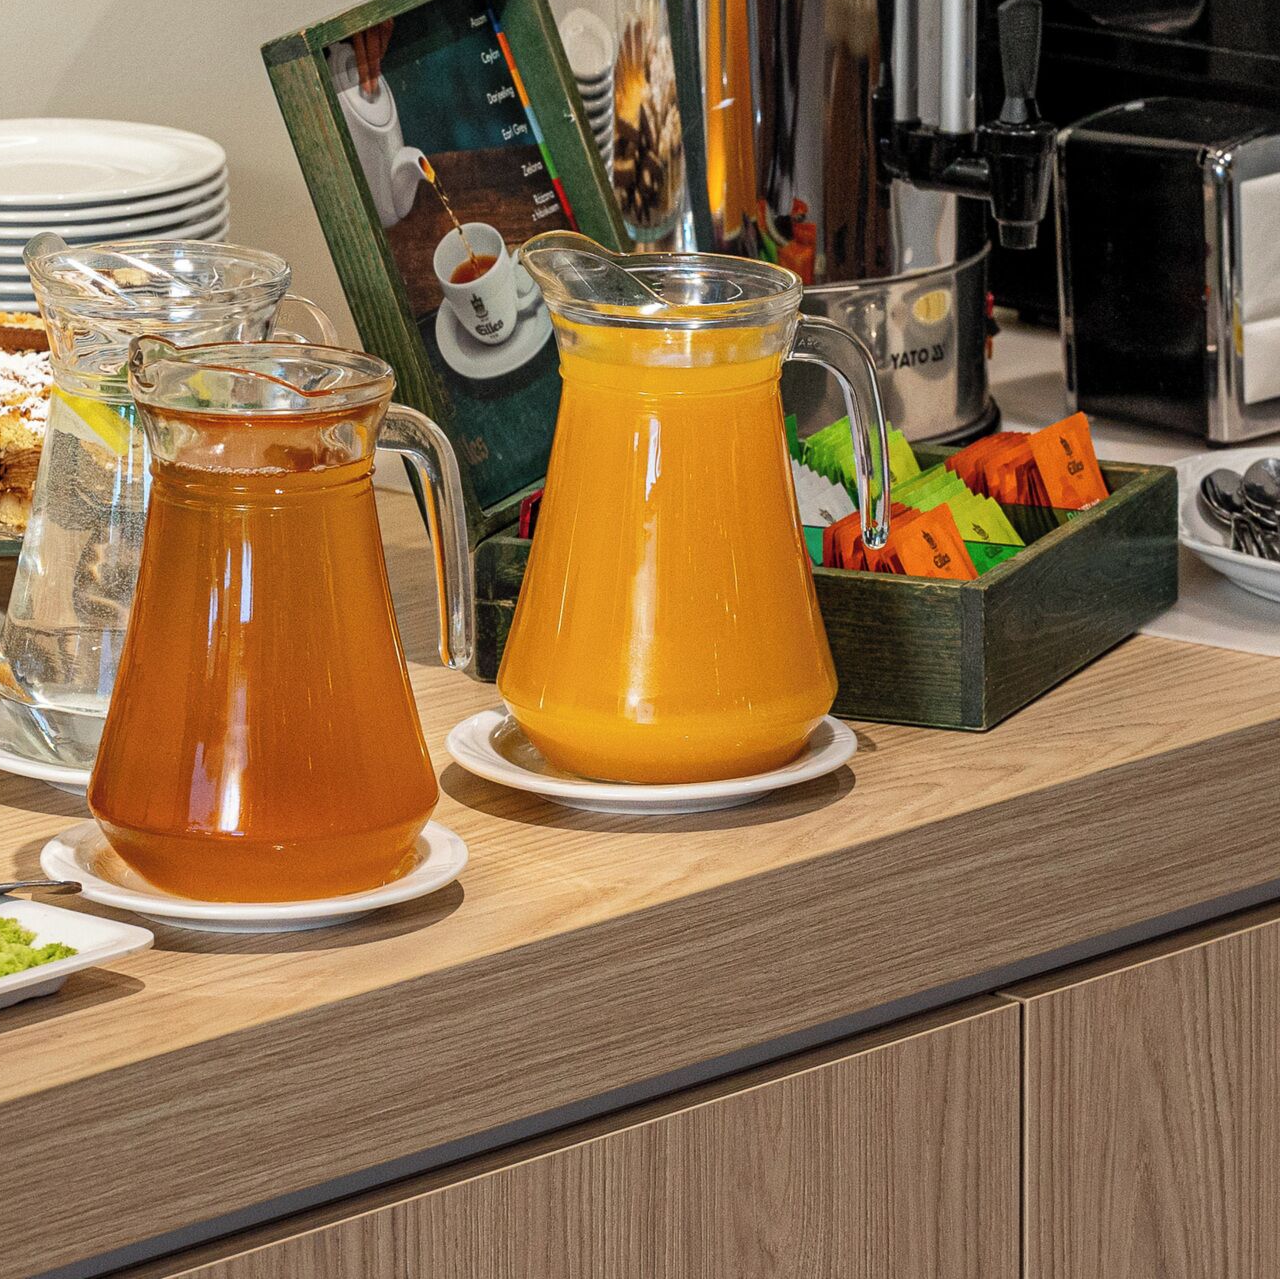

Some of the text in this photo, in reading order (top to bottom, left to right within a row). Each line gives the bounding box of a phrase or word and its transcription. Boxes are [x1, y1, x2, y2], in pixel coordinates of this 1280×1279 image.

[480, 48, 499, 64] Ceylon
[486, 86, 515, 104] Darjeeling
[501, 123, 528, 140] Earl Grey
[891, 348, 929, 370] YATO
